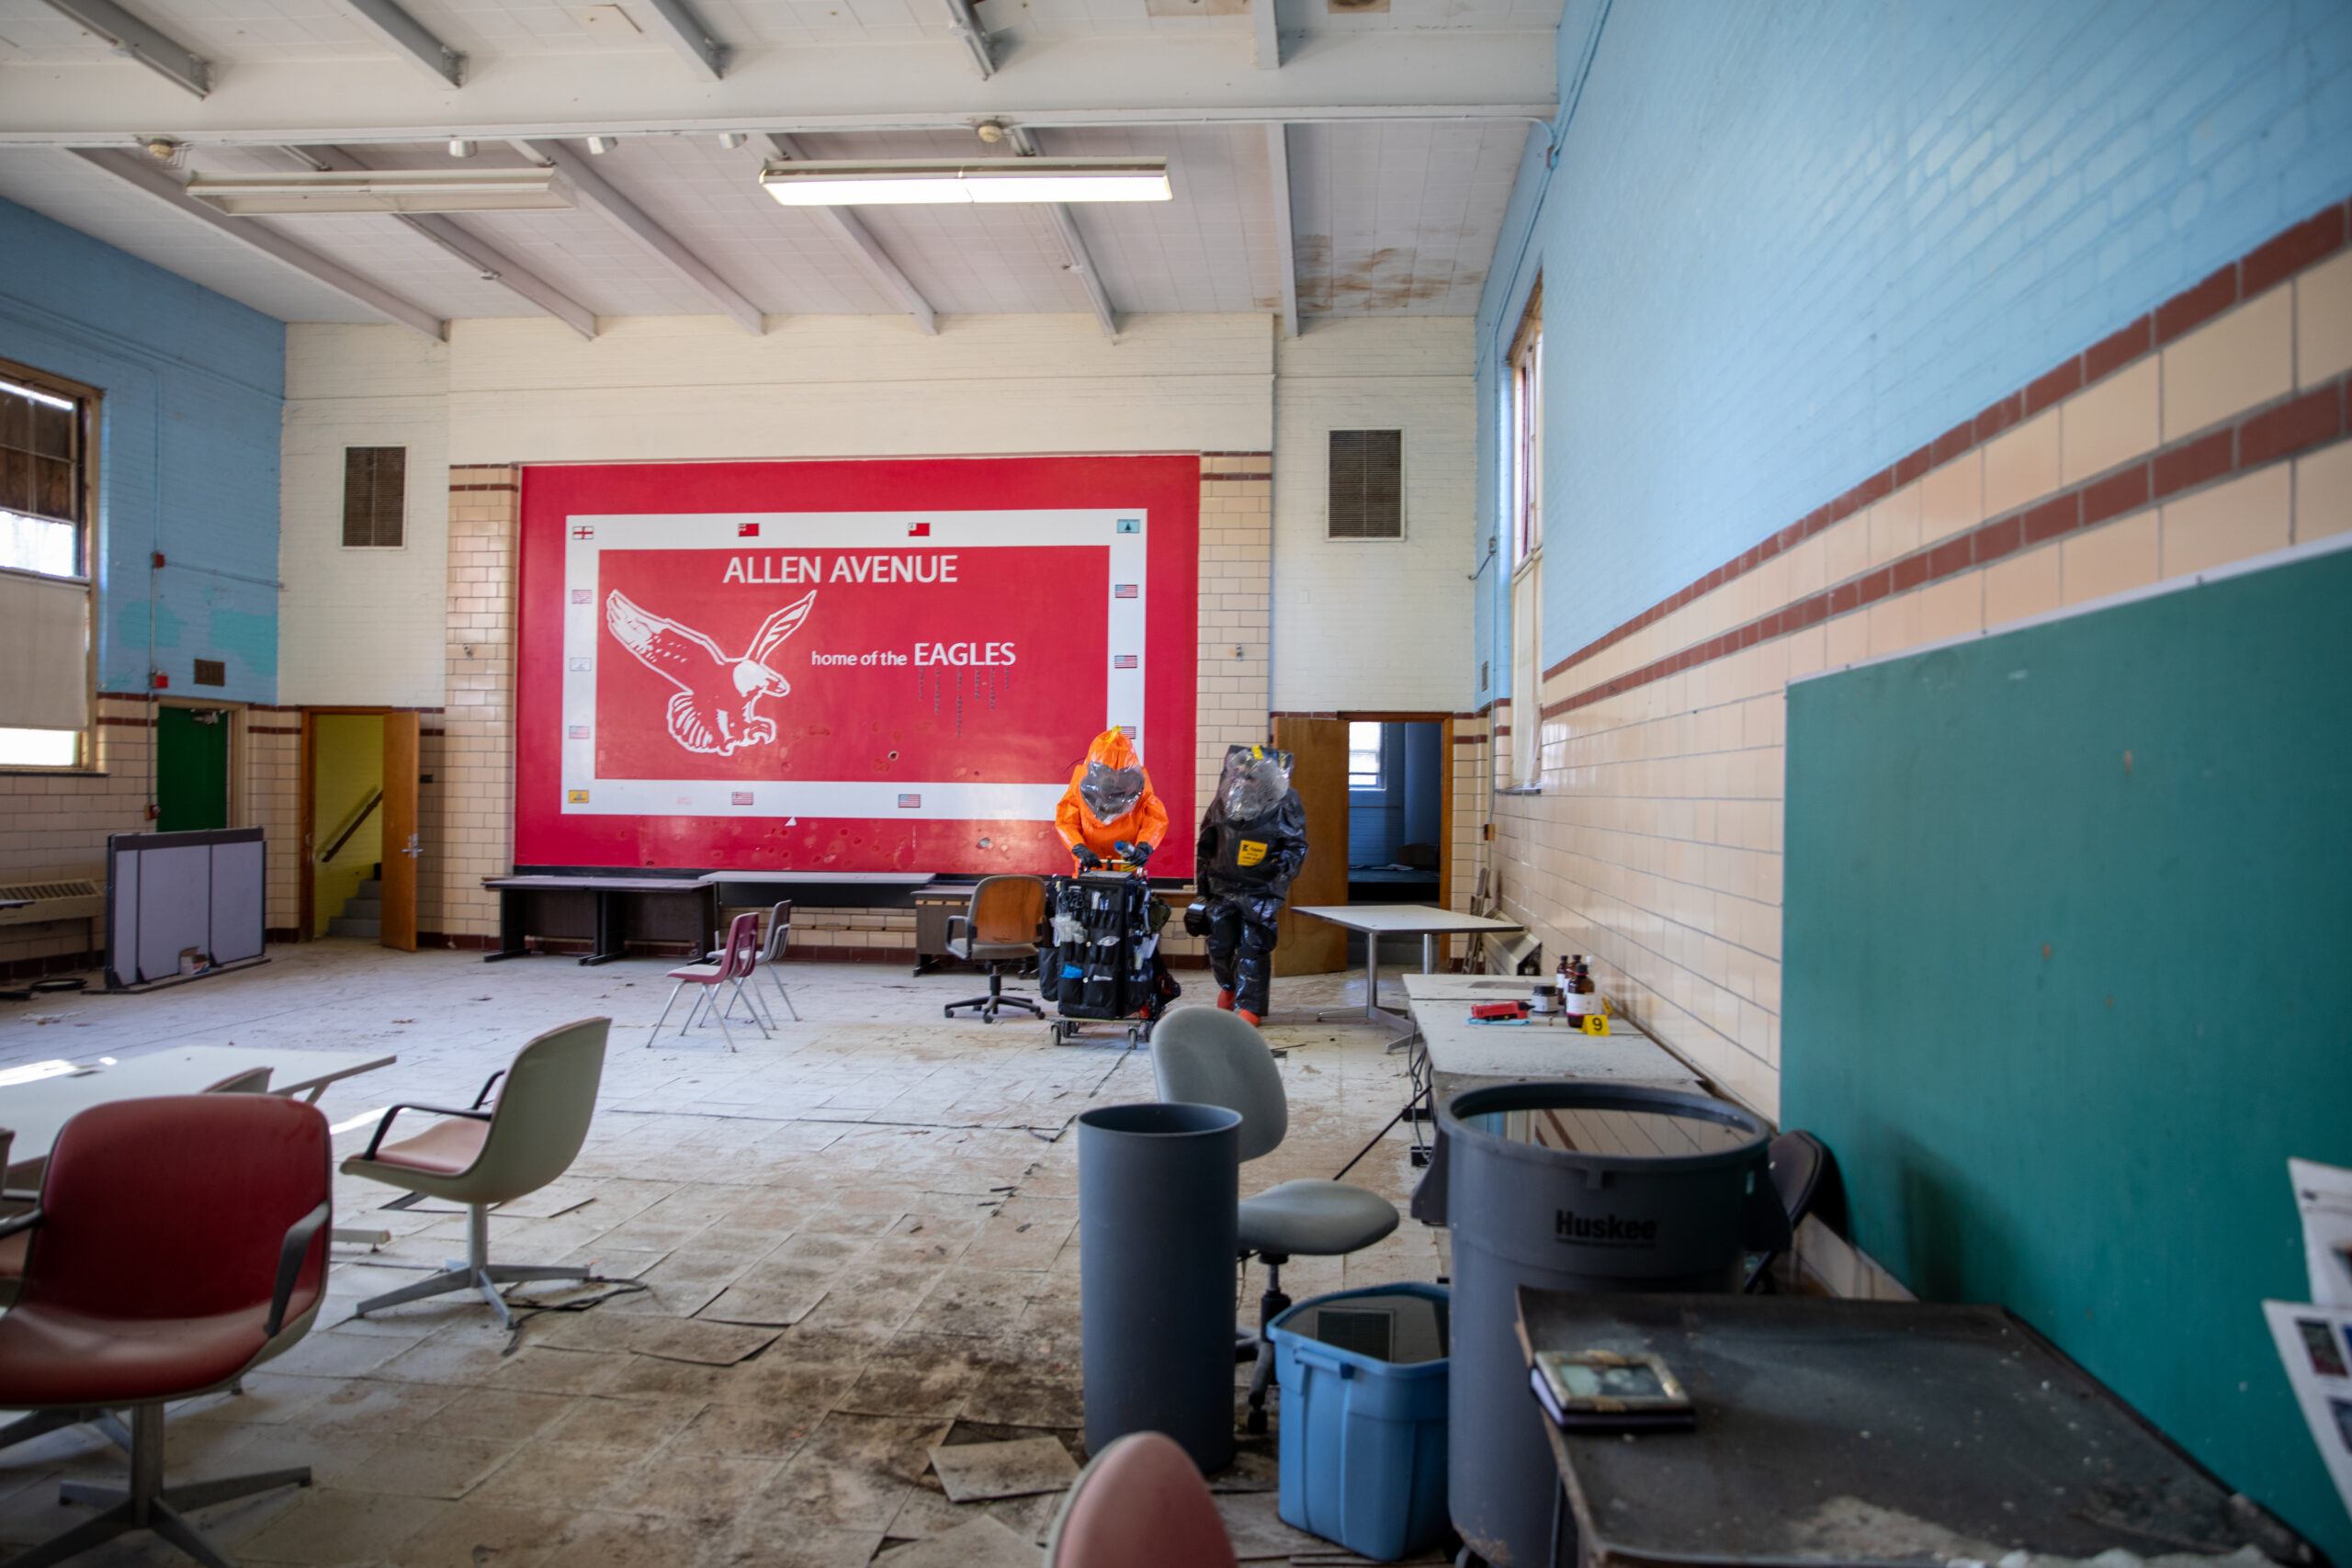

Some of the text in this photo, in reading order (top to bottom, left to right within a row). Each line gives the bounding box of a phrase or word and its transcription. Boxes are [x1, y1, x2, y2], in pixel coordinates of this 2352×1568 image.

[722, 554, 958, 583] ALLEN AVENUE
[811, 642, 1016, 666] home of the EAGLES
[1592, 1017, 1602, 1032] 9
[1555, 1209, 1657, 1240] Huskee
